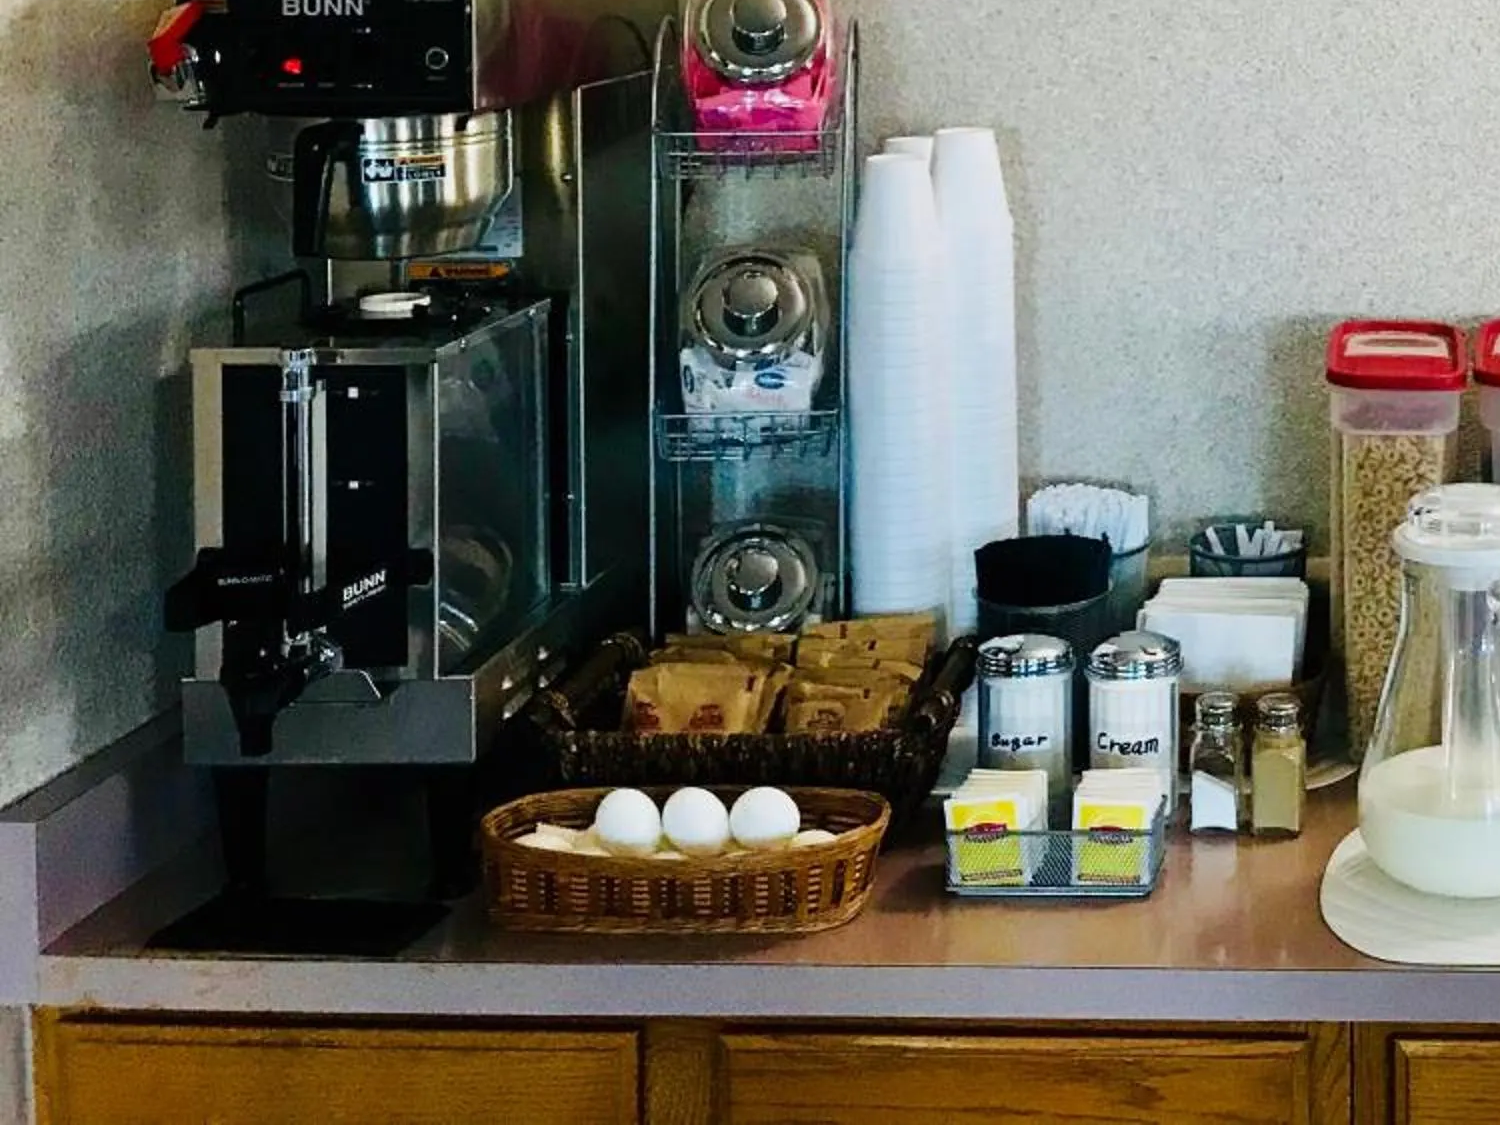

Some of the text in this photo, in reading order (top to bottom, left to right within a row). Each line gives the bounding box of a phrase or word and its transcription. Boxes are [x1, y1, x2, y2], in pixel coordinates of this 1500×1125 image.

[342, 569, 387, 602] BUNN
[991, 731, 1049, 752] Sugar
[1097, 731, 1160, 756] Cream
